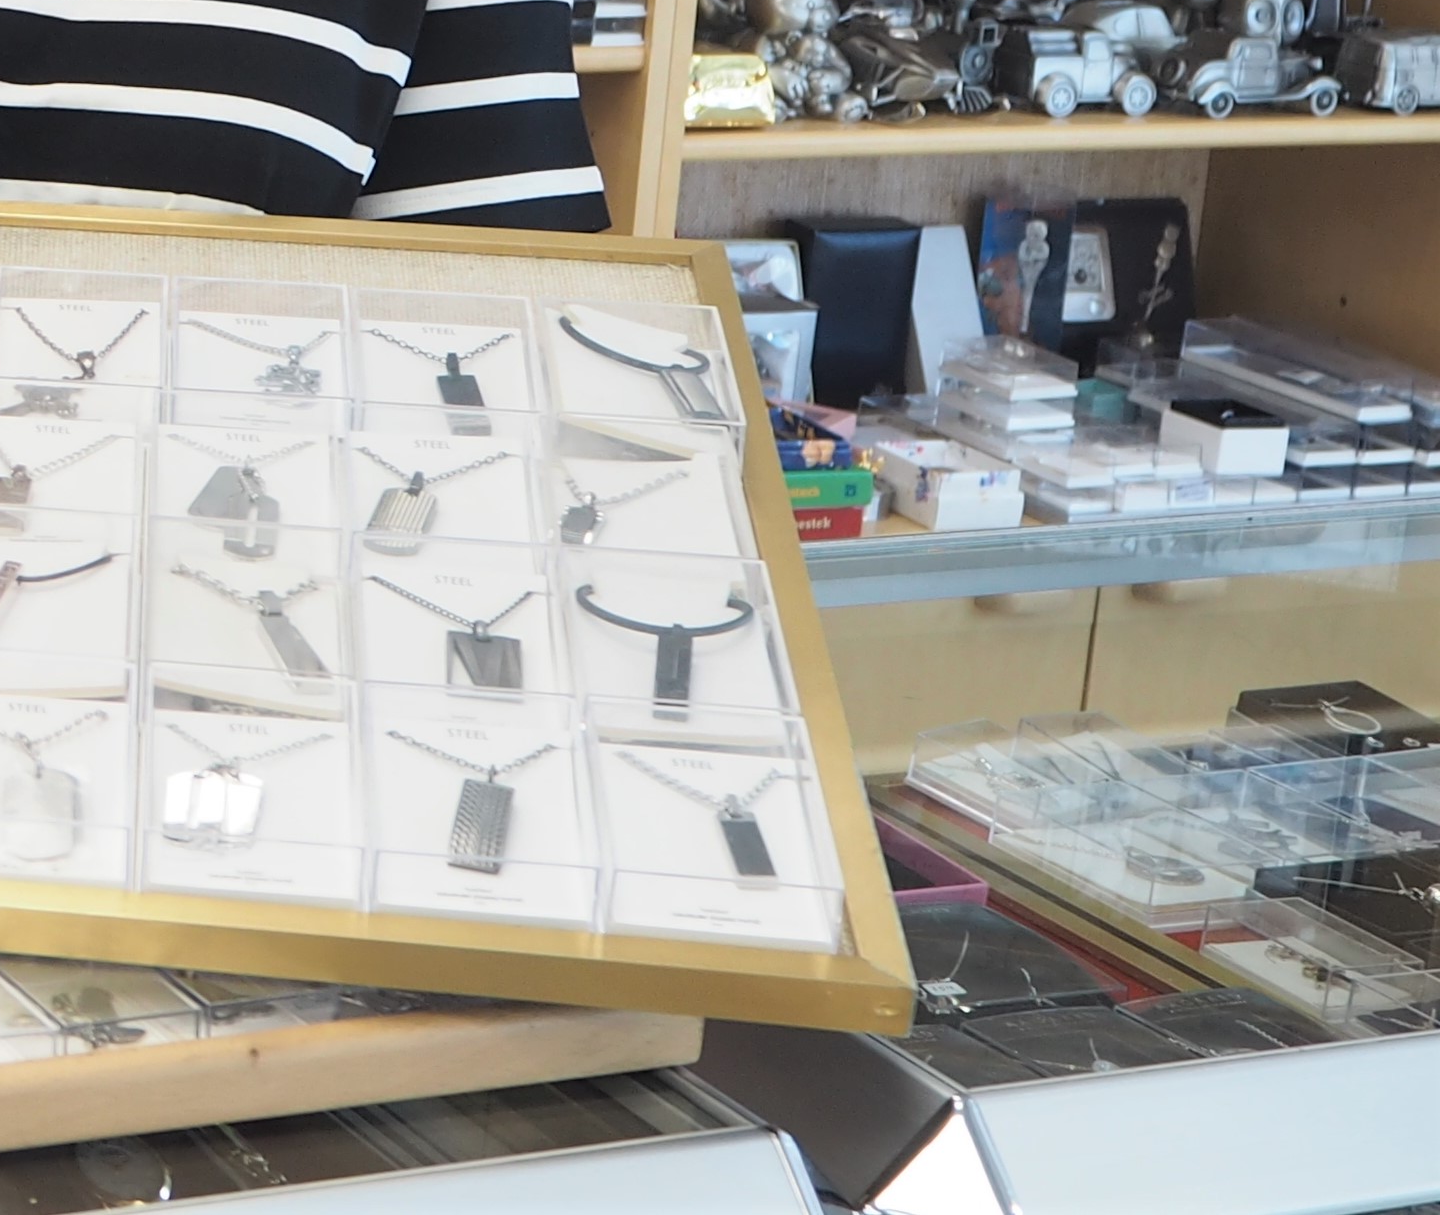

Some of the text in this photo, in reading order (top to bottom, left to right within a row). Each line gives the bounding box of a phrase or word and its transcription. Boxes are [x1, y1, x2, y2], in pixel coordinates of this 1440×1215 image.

[59, 304, 92, 312] STEEL
[235, 318, 270, 327] STEEL
[422, 326, 456, 336] STEEL
[35, 425, 71, 435] STEEL
[226, 433, 262, 443] STEEL
[414, 439, 451, 450] STEEL
[435, 575, 473, 587] STEEL
[9, 703, 46, 714] STEEL
[229, 723, 269, 735] STEEL
[448, 728, 489, 741] STEEL
[672, 758, 713, 770] STEEL
